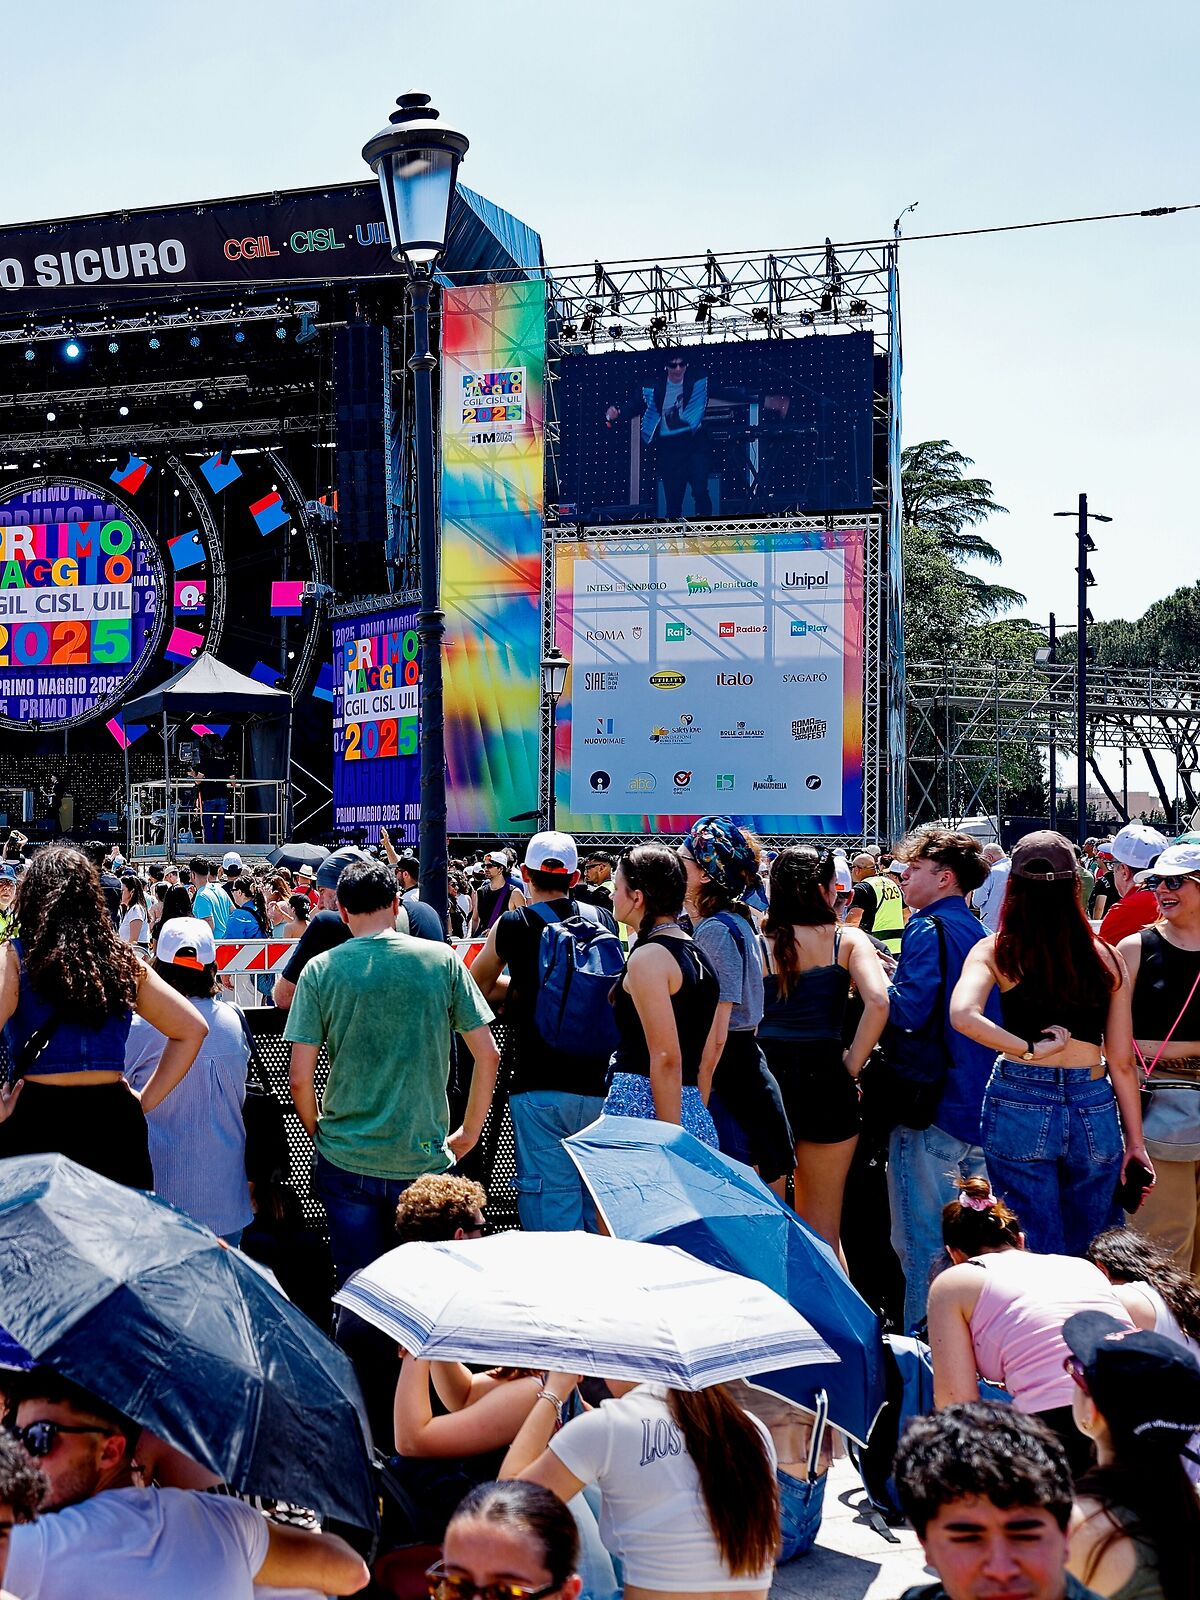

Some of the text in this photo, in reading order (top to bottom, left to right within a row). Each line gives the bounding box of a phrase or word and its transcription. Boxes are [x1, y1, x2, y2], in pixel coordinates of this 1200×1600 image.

[224, 222, 391, 261] CGIL CISL UIL
[34, 239, 187, 287] SICURO
[463, 372, 522, 388] PRIMO
[464, 383, 522, 397] MAGGIO
[486, 396, 505, 404] CISL
[463, 405, 522, 423] 2025
[714, 580, 758, 590] plenitude
[785, 570, 828, 589] Unipol
[35, 593, 84, 613] CISL
[92, 591, 130, 611] UIL
[586, 630, 625, 640] ROMA
[667, 627, 692, 636] Rai 3
[720, 626, 733, 634] Rai
[344, 630, 418, 671] PRIMO
[38, 677, 87, 695] MAGGIO
[344, 660, 419, 695] MAGGIO
[585, 672, 606, 690] SIAE
[716, 672, 753, 686] italo
[19, 698, 66, 719] PRIMO
[345, 698, 369, 716] CGIL
[372, 693, 396, 713] CISL
[399, 691, 418, 710] UIL
[791, 718, 815, 729] ROMA
[791, 723, 827, 736] SUMMER
[344, 716, 418, 760] 2025
[807, 731, 826, 740] FEST
[336, 807, 355, 823] PRIMO
[357, 806, 381, 822] MAGGIO
[382, 805, 400, 821] 2025
